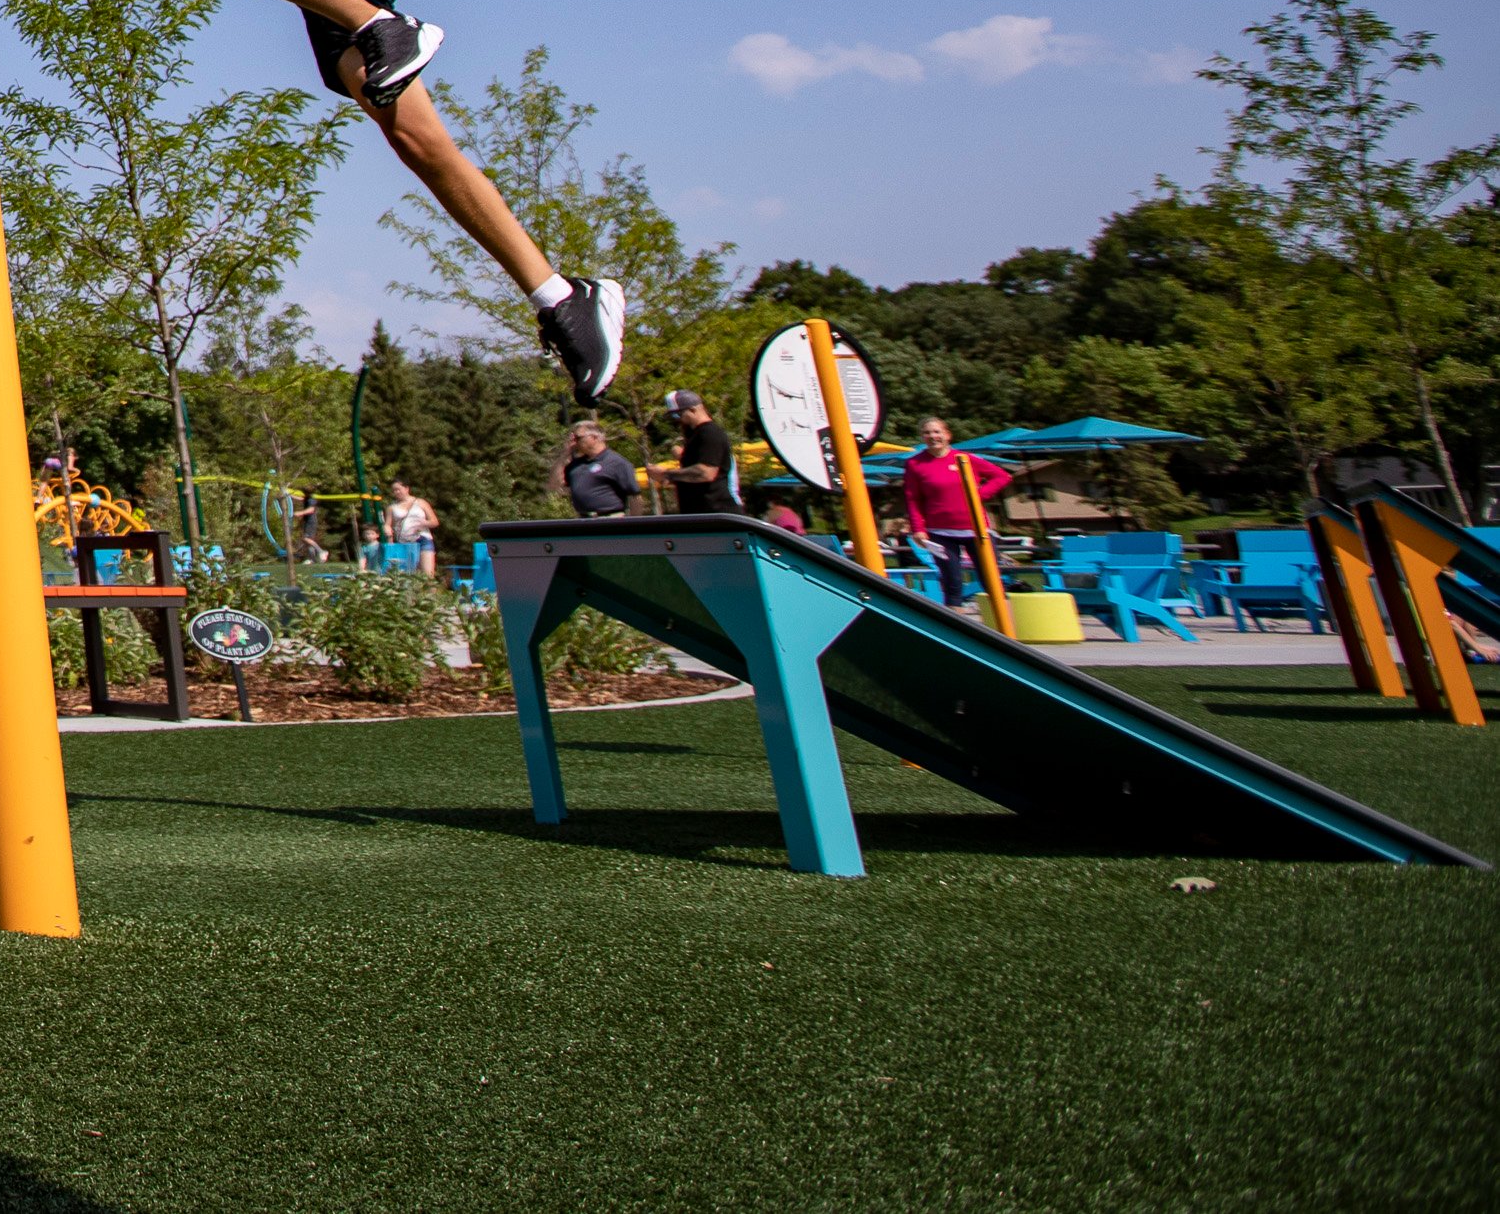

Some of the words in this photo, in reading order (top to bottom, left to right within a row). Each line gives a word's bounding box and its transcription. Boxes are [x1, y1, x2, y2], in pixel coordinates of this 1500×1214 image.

[196, 612, 226, 629] PLEASE
[226, 613, 243, 624] STAY
[244, 618, 262, 631] OUT
[202, 638, 214, 649] OF
[215, 644, 244, 656] PLANT
[245, 642, 264, 656] AREA
